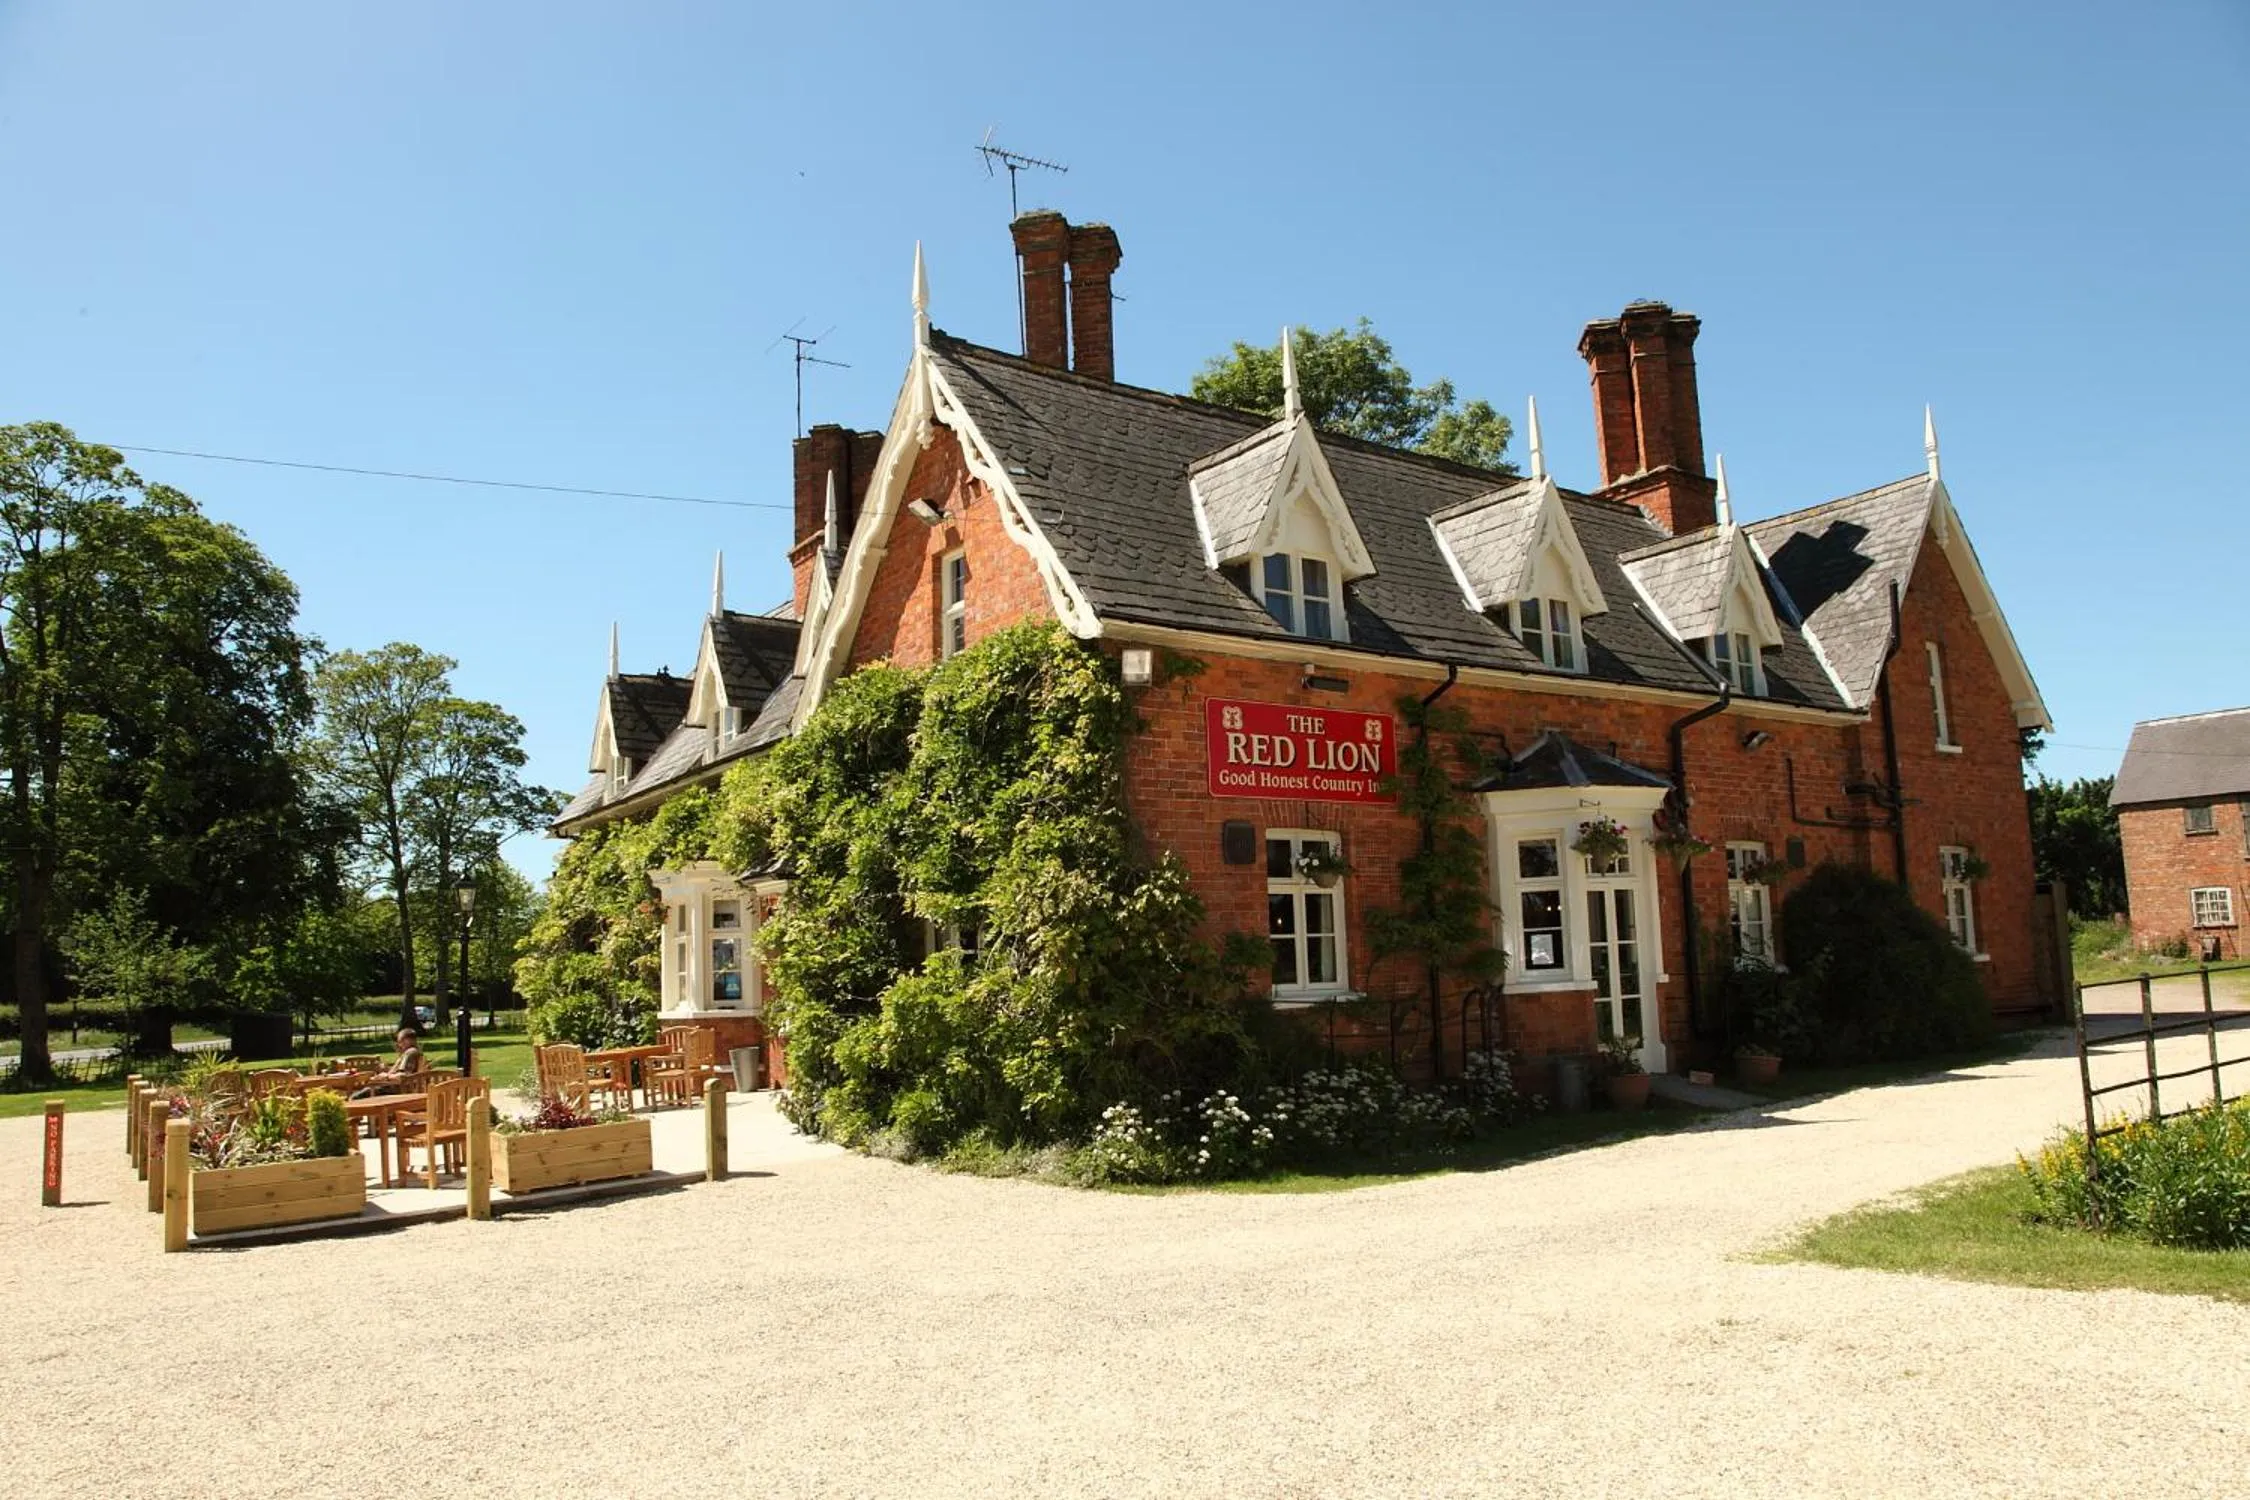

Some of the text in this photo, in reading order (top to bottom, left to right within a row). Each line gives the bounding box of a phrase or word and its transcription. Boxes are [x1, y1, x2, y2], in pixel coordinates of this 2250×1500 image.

[1286, 714, 1325, 735] THE
[1226, 731, 1382, 774] RED LION
[1219, 769, 1256, 787] Good
[1260, 773, 1310, 790] Honest
[1312, 775, 1363, 796] Country
